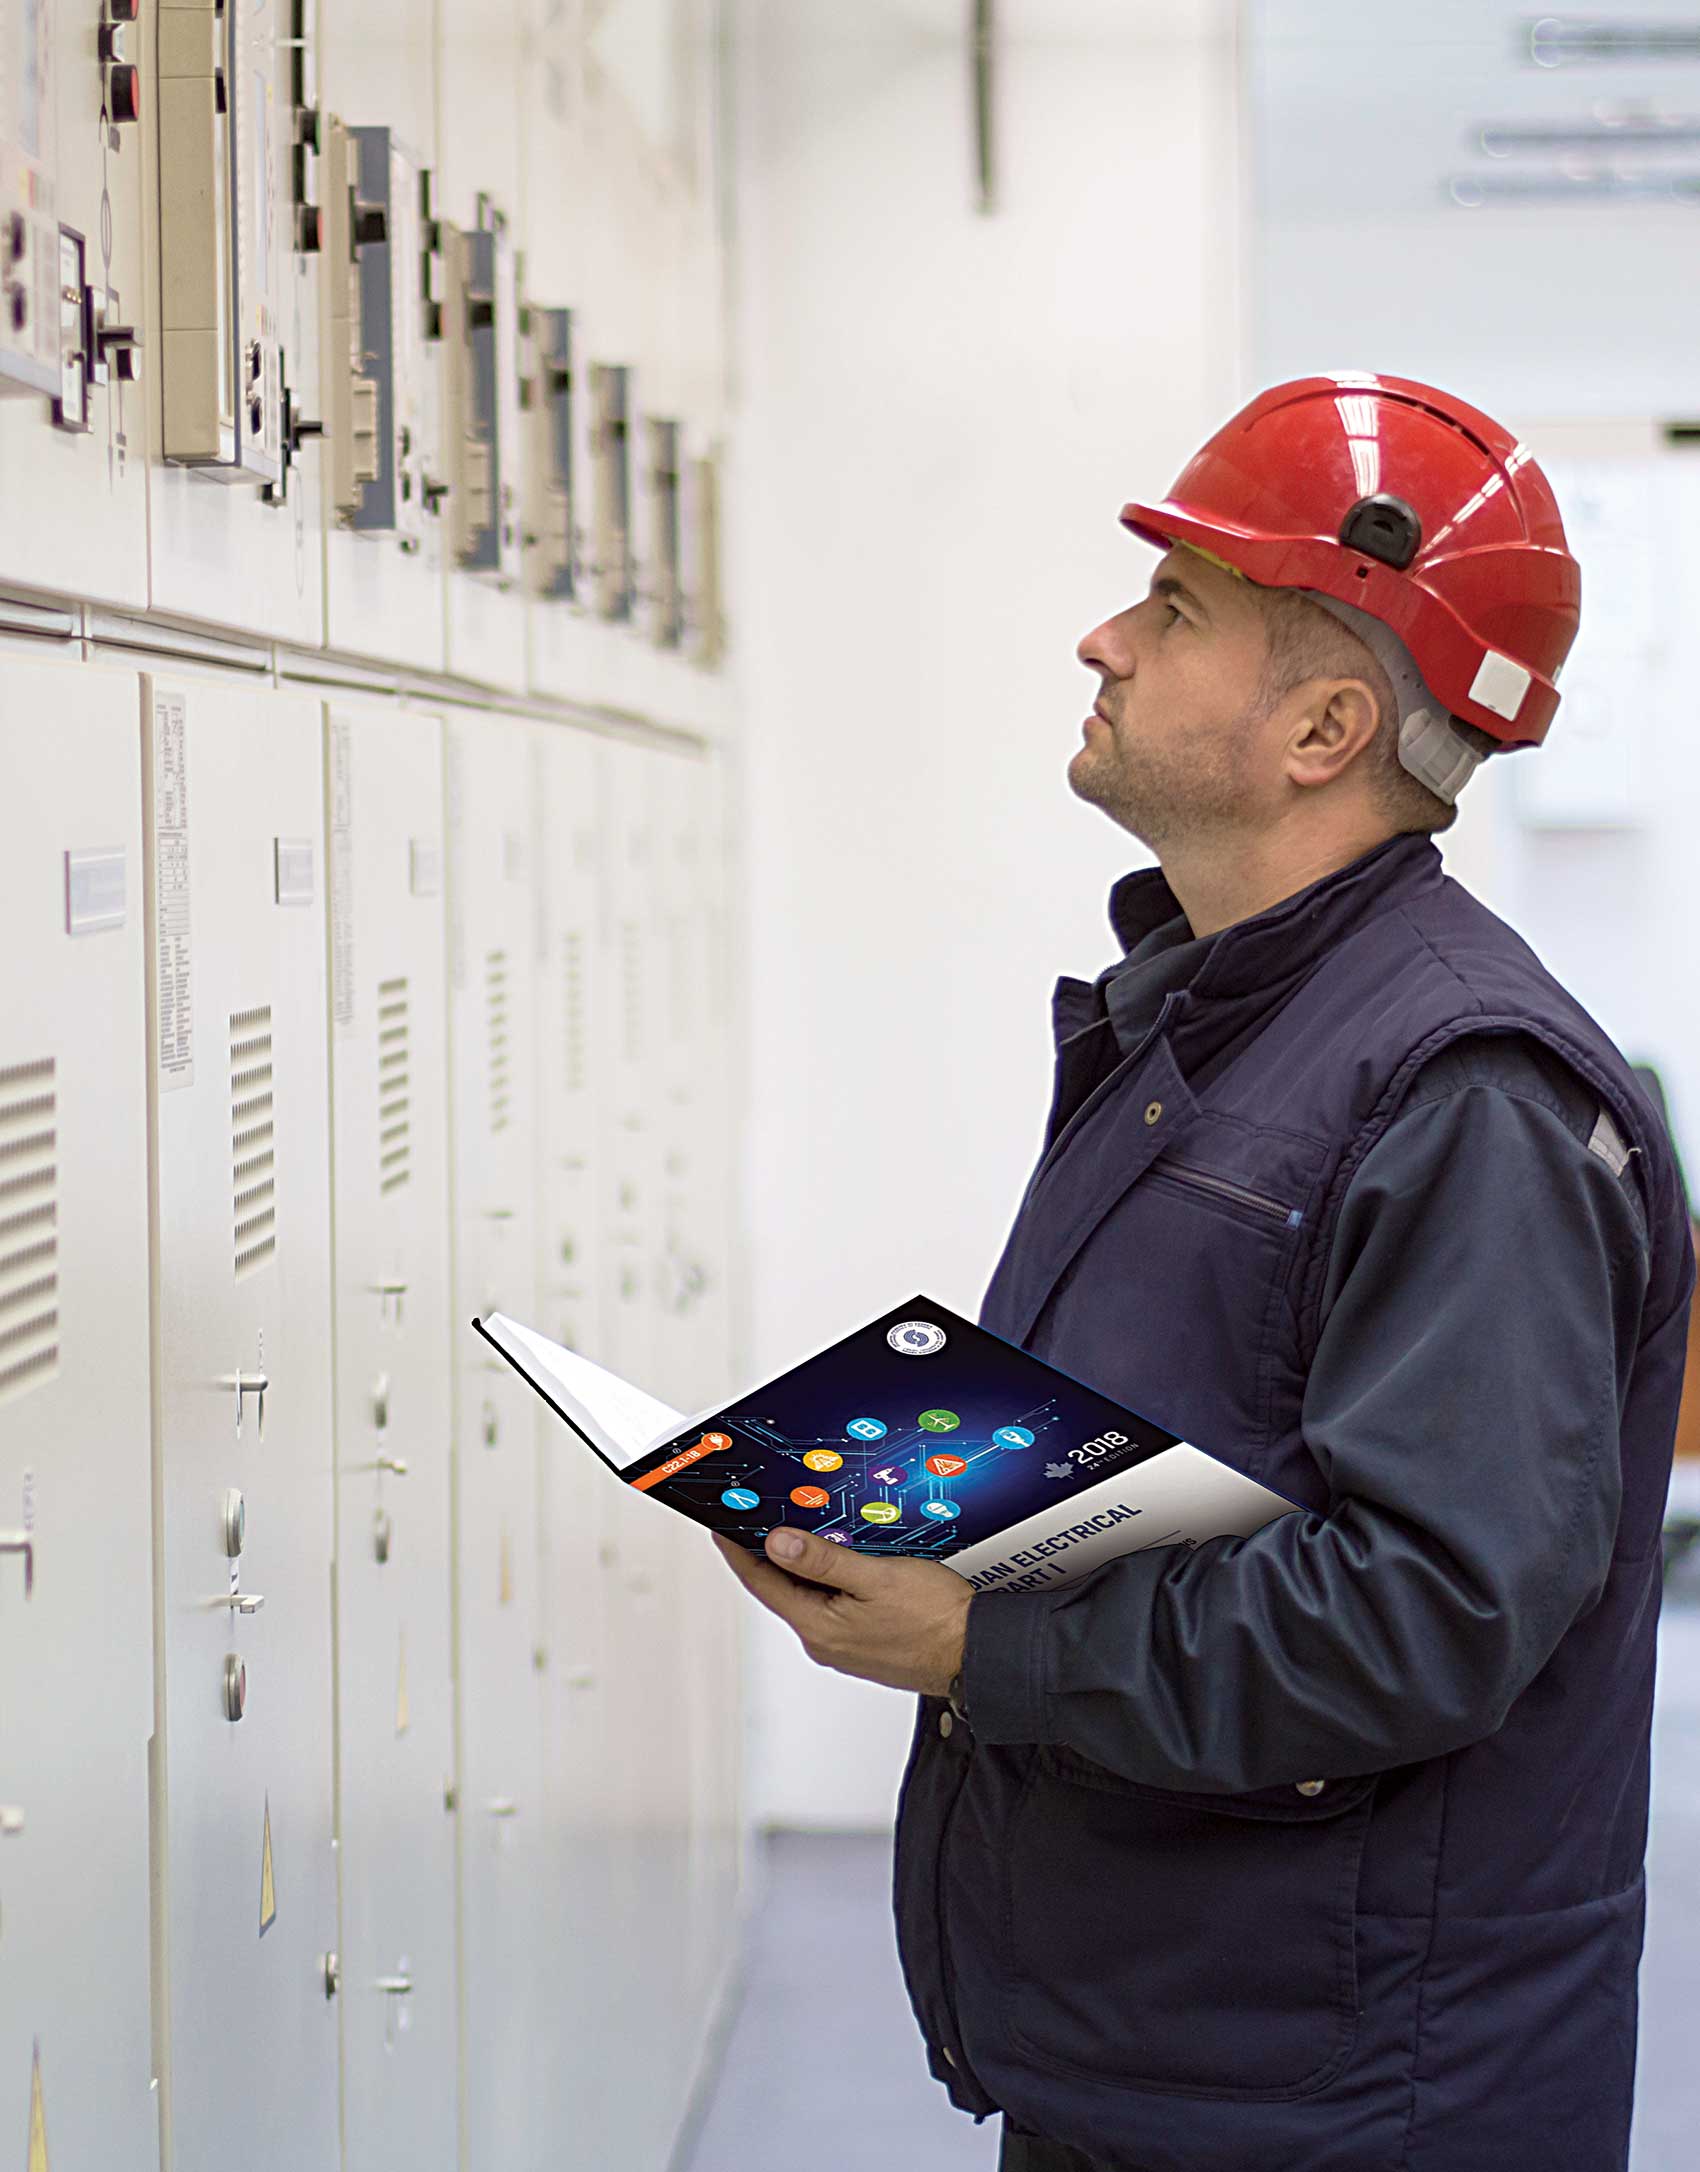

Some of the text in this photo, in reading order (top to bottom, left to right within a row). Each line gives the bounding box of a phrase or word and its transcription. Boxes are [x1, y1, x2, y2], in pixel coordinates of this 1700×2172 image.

[1067, 1431, 1129, 1465] 2018
[1103, 1443, 1139, 1462] EDITION
[661, 1450, 701, 1473] C22.1-18
[1010, 1503, 1143, 1568] ELECTRICAL
[1047, 1562, 1067, 1574] I
